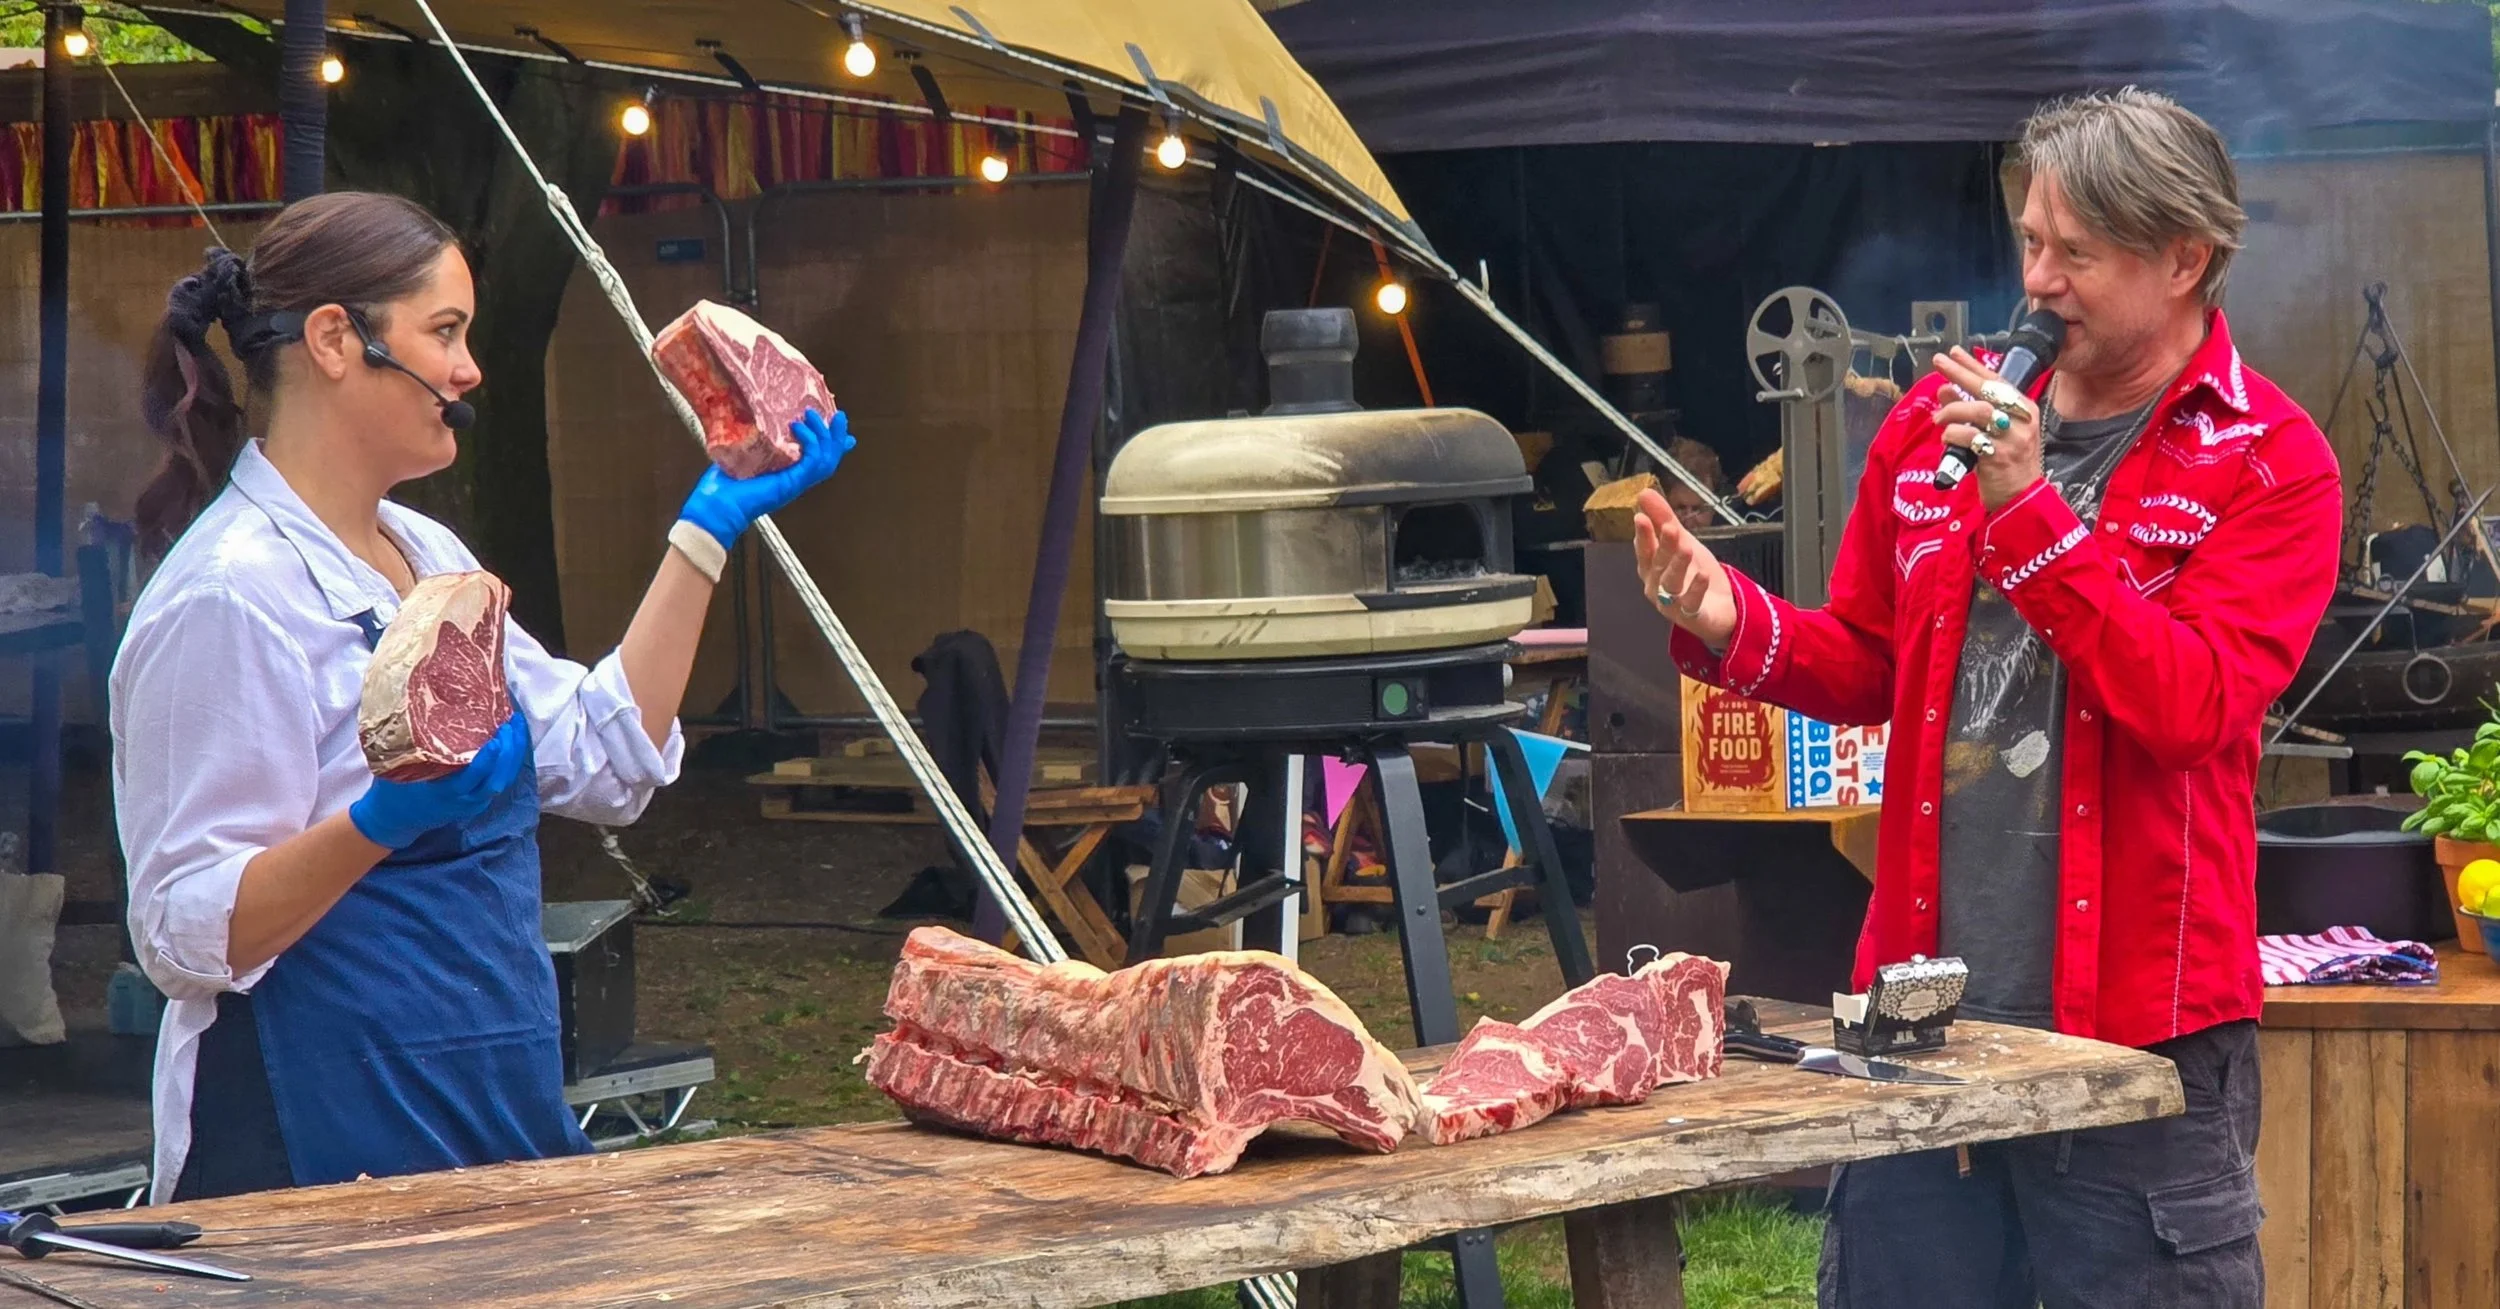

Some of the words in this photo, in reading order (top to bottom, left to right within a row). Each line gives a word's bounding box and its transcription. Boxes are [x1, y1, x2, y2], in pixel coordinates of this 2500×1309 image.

[1712, 712, 1756, 736] FIRE
[1709, 737, 1762, 761] FOOD
[1808, 720, 1832, 797] BBQ
